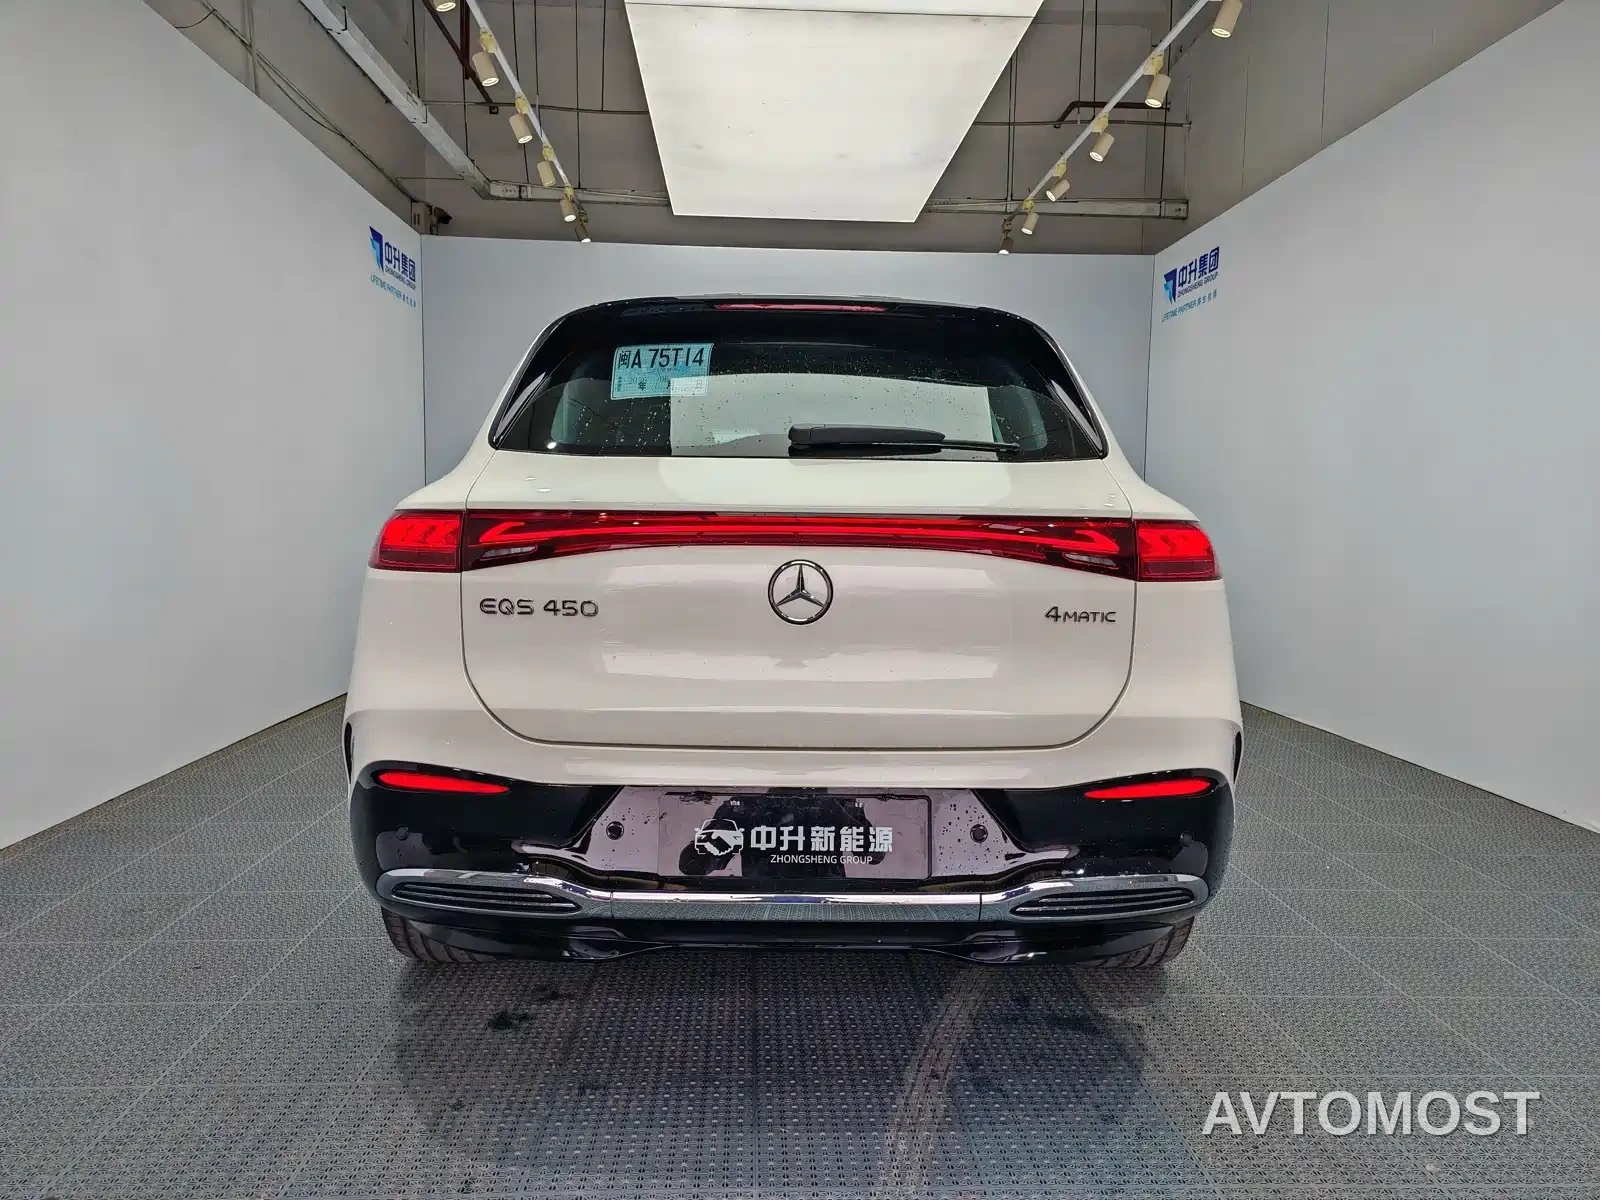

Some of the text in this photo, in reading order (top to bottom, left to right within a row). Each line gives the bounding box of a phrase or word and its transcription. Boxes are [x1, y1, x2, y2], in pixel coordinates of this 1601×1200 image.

[384, 241, 416, 282] 中升集团
[1178, 246, 1219, 287] 中升集团
[480, 597, 599, 617] EQS 450
[1044, 605, 1117, 623] 4MATIC
[750, 825, 893, 853] 中升新能源
[770, 854, 873, 866] ZHONGSHENG GROUP
